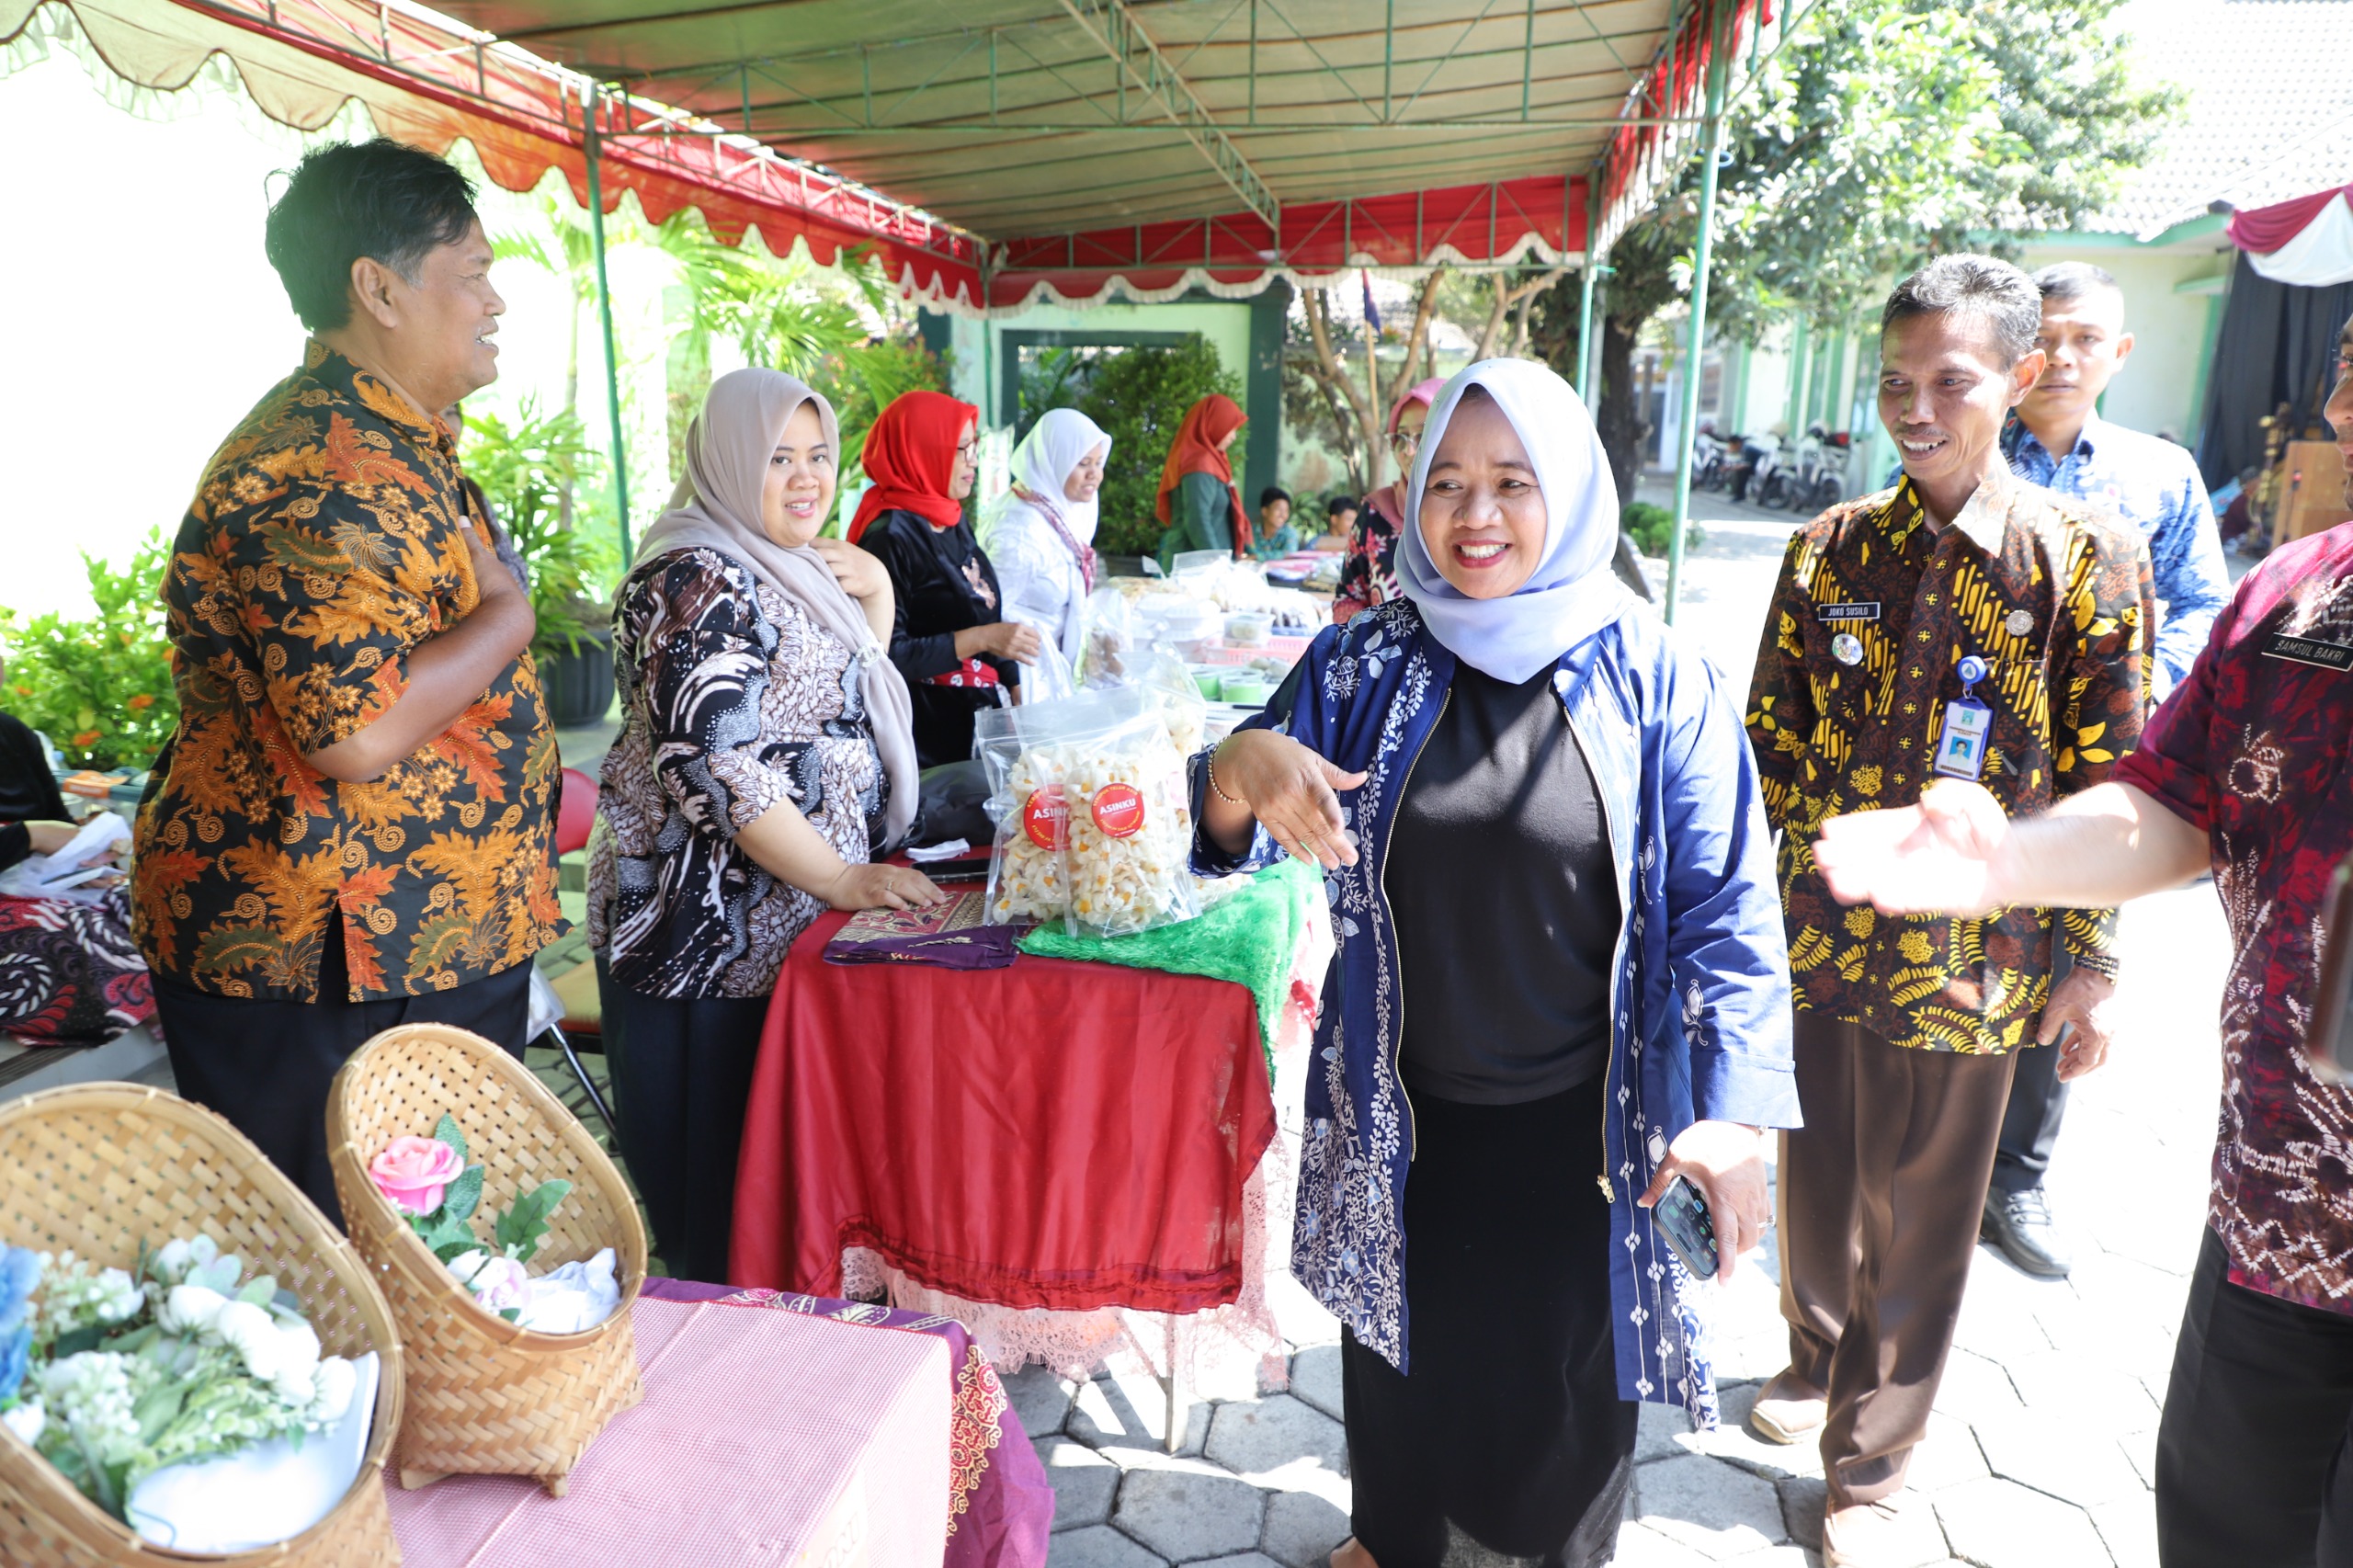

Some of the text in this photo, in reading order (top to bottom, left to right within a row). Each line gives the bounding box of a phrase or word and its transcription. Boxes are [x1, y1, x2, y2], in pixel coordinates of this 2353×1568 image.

[1828, 606, 1869, 617] JOKO SUSILO
[2275, 640, 2346, 662] SAMSUL BAKRI
[1033, 807, 1069, 820] ASINK
[1099, 798, 1136, 815] ASINKU
